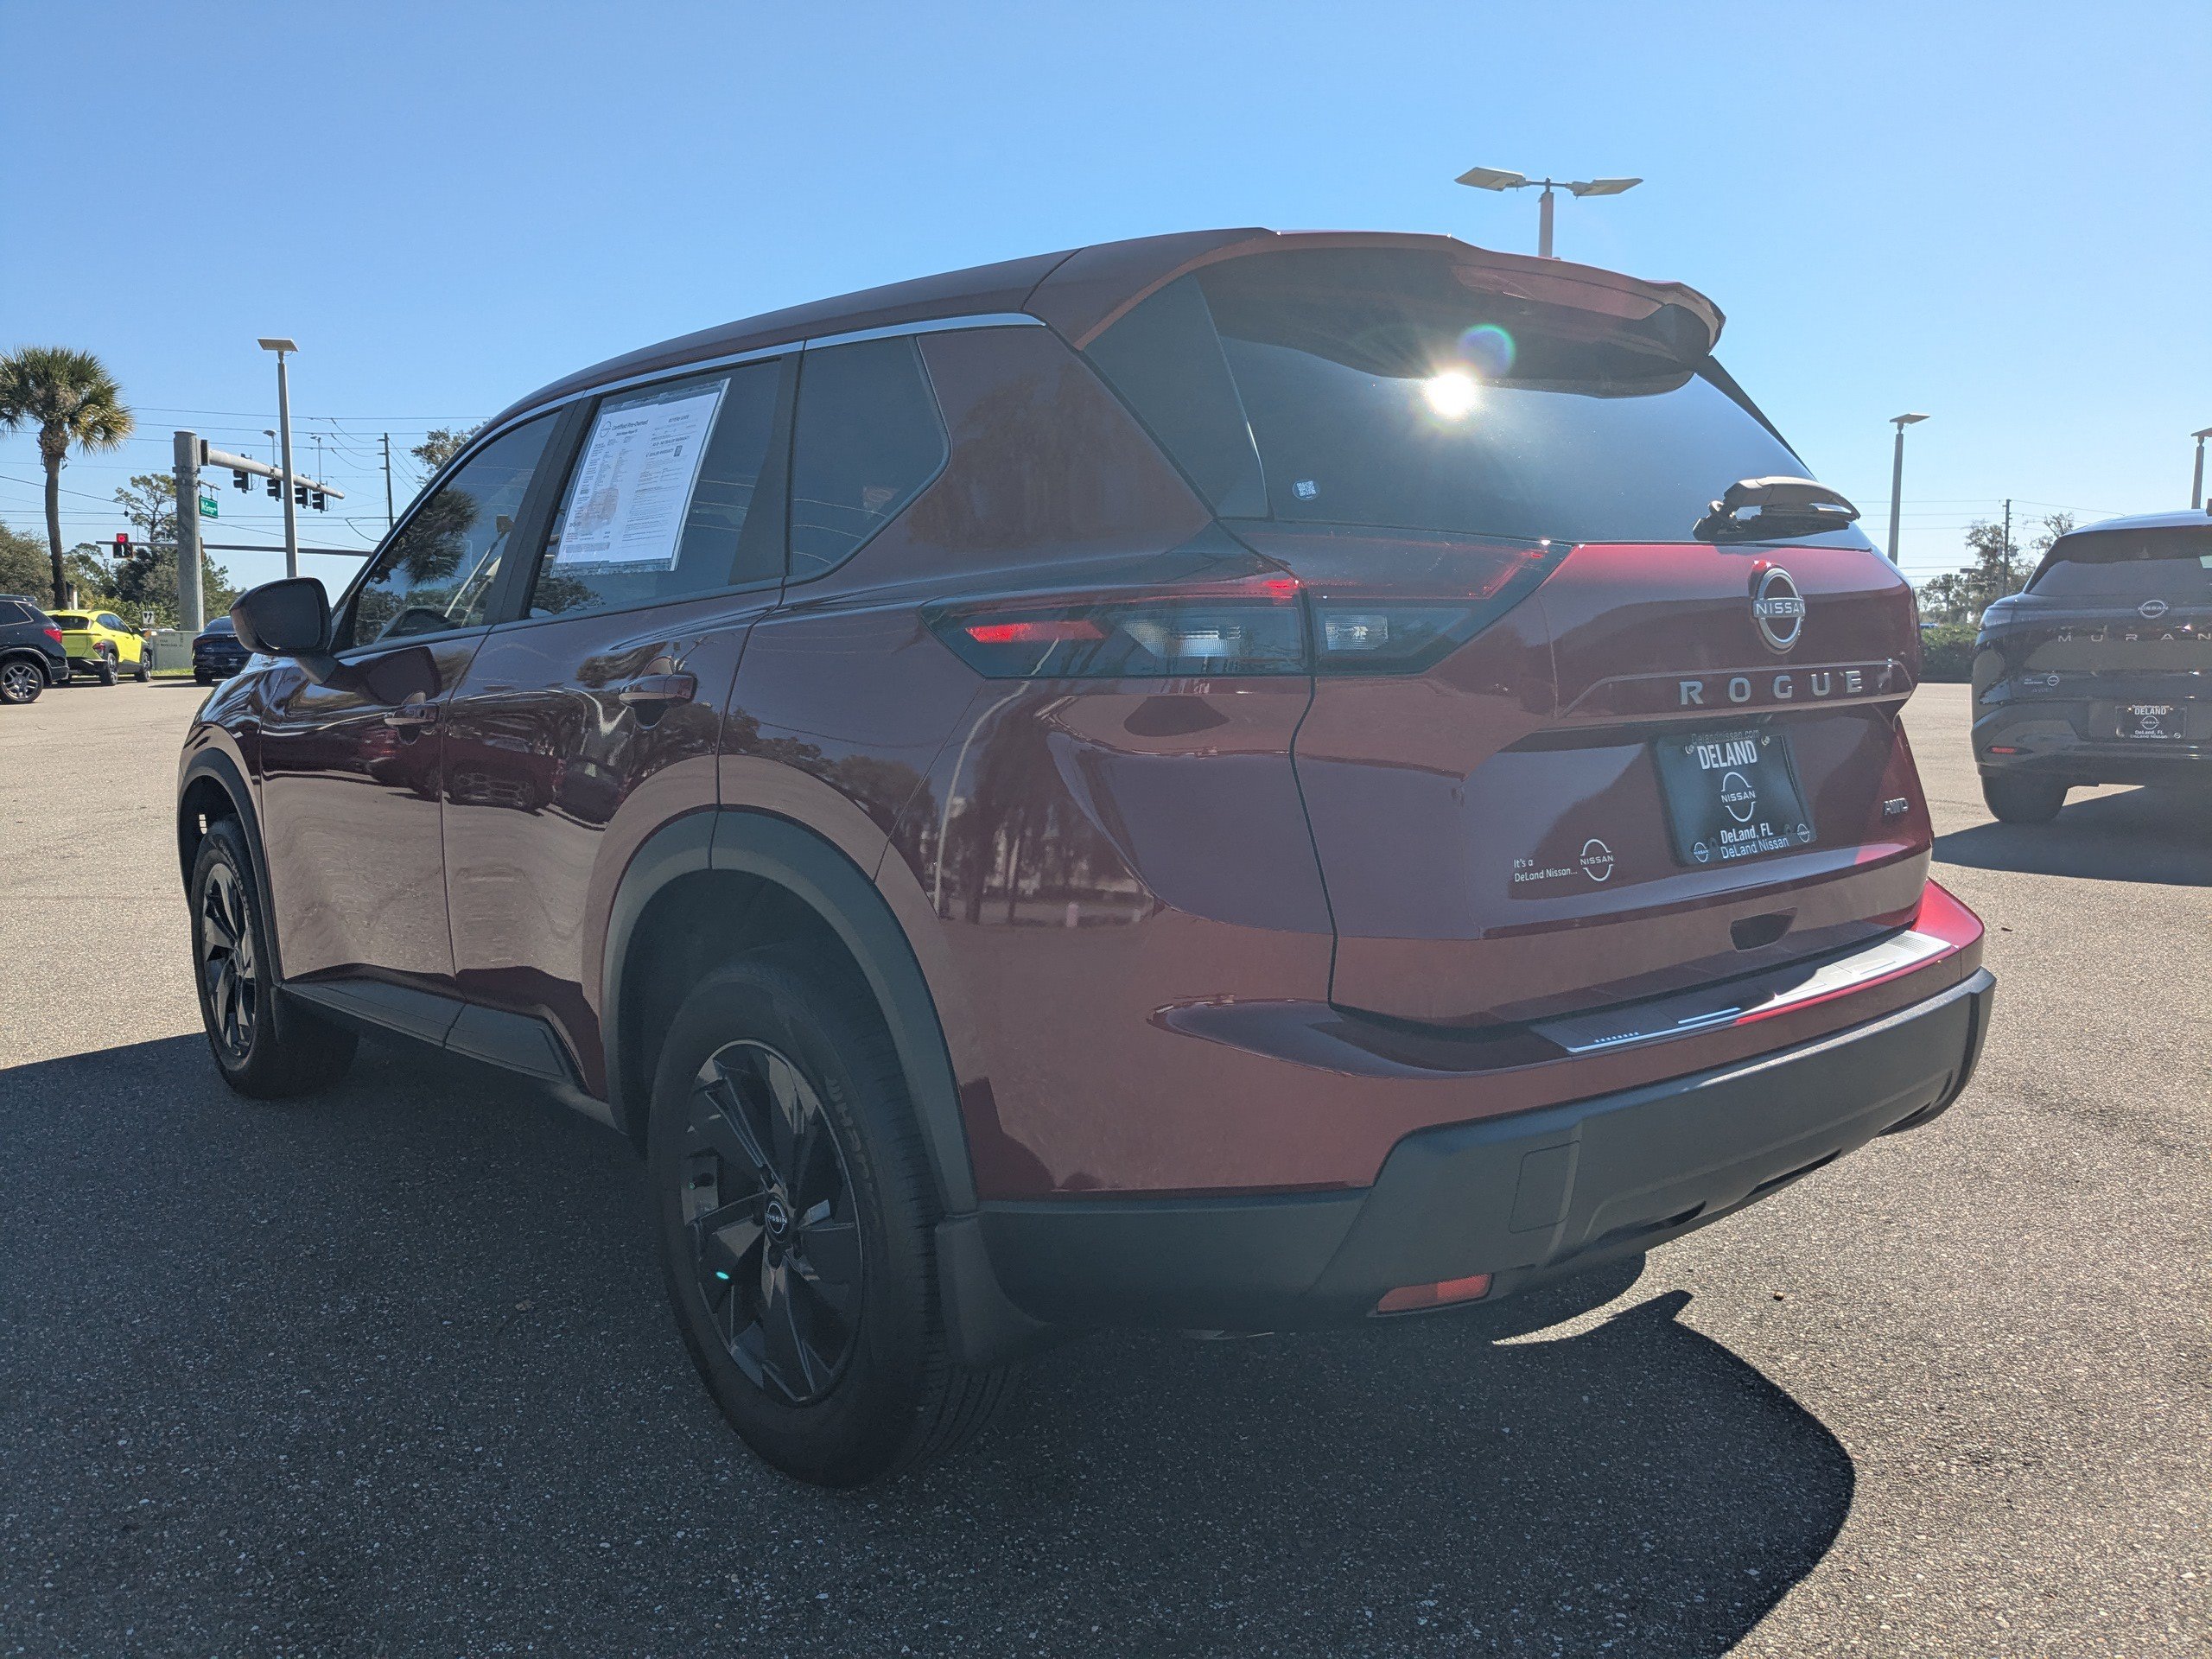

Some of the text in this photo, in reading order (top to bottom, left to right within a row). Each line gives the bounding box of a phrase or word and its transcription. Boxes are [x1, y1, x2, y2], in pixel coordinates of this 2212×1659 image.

[1756, 601, 1806, 615] NISSAN
[1679, 671, 1862, 705] ROGUE
[1696, 740, 1758, 770] DELAND
[1720, 791, 1757, 804] NISSAN
[1720, 822, 1774, 844] DeLand, FL
[1720, 836, 1790, 859] DeLand Nissan
[1513, 858, 1526, 868] It's
[1580, 855, 1614, 866] NISSAN
[1515, 869, 1544, 882] DeLand
